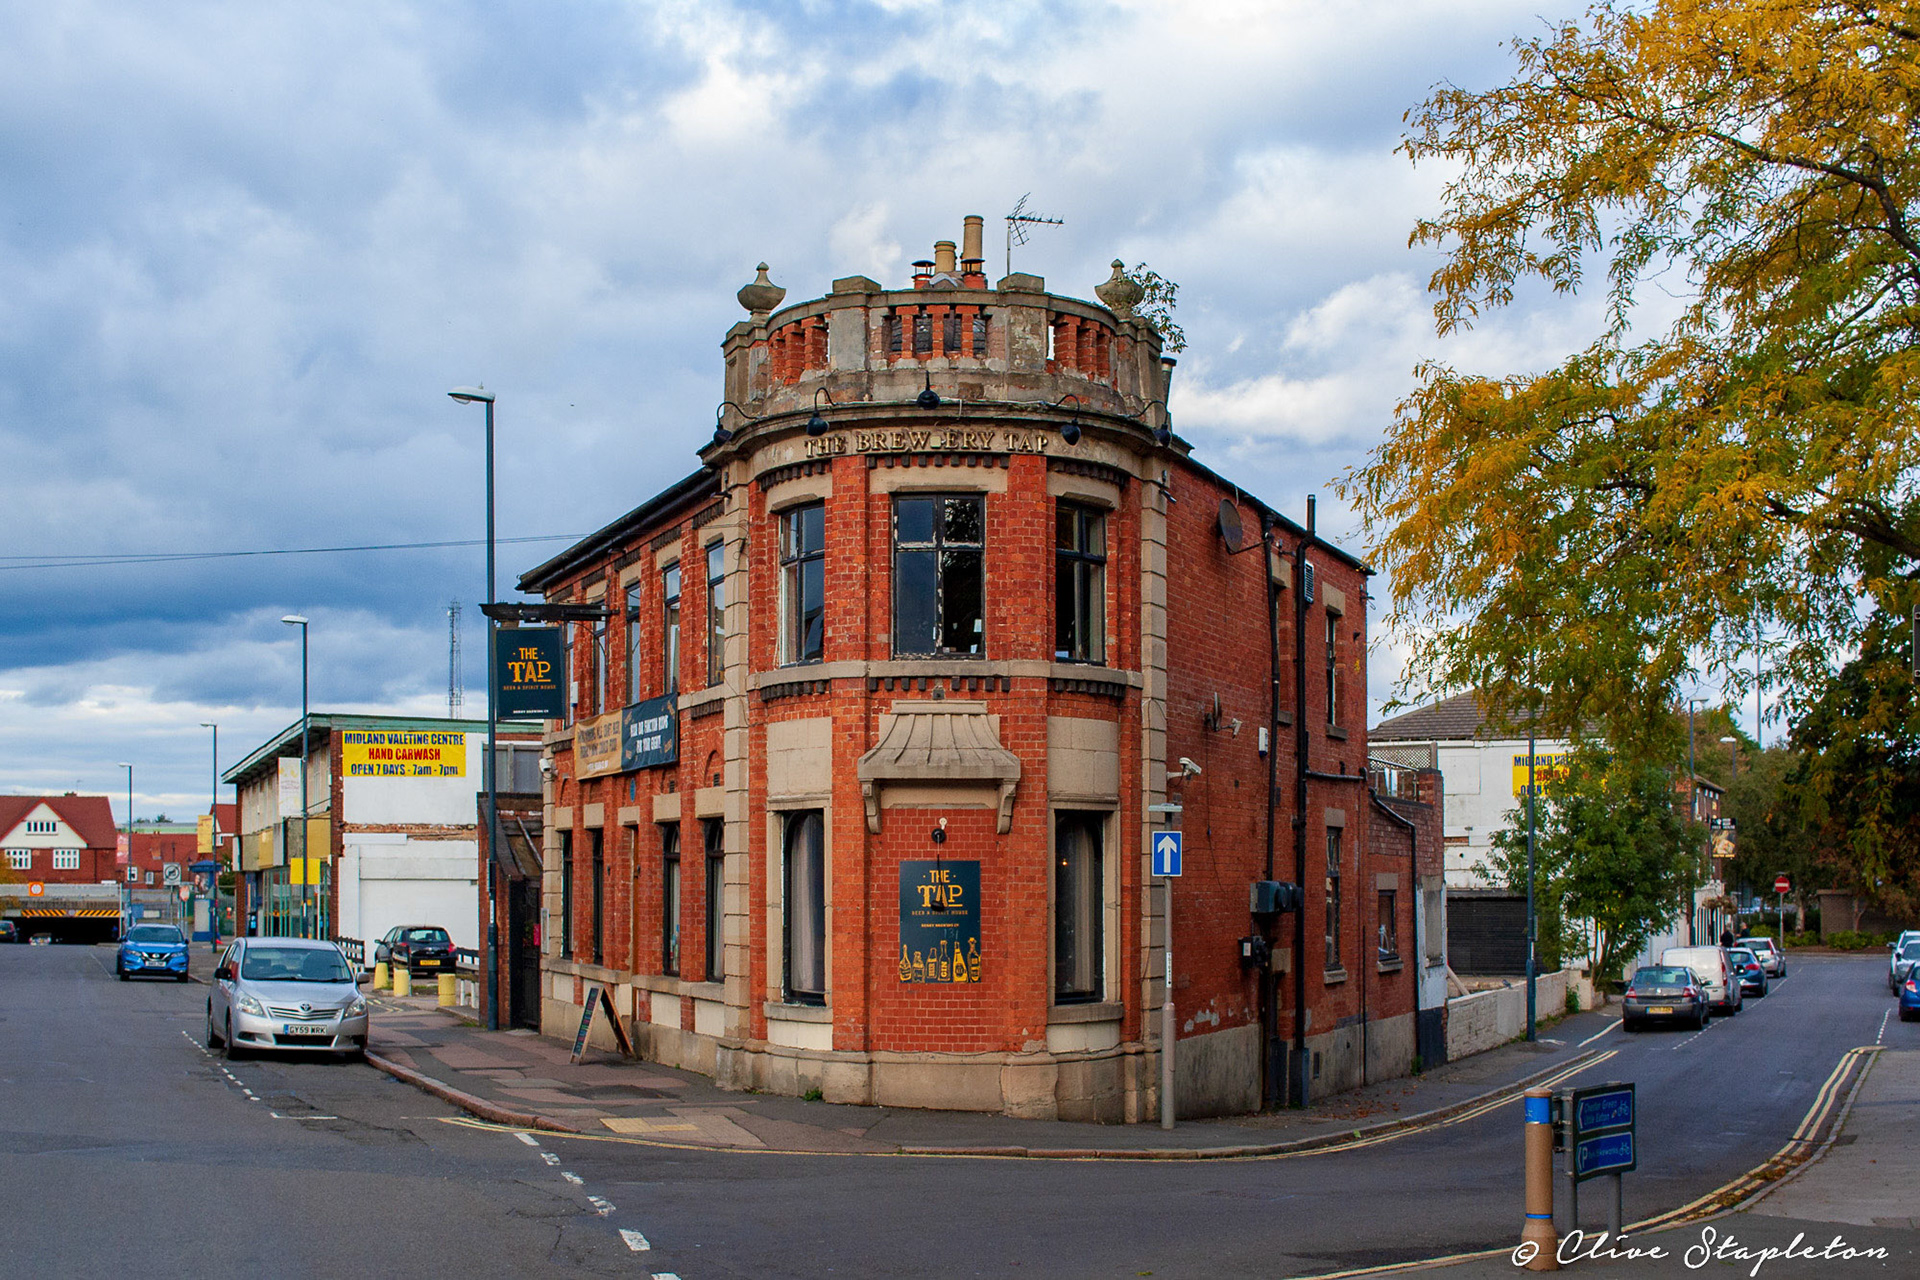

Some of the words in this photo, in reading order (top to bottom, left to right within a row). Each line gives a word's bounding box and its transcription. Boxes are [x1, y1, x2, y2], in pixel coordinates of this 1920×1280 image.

[805, 435, 846, 458] THE
[856, 430, 995, 453] BREWERY
[1003, 432, 1049, 453] TAP
[518, 647, 539, 660] THE
[507, 661, 551, 683] TAP
[344, 733, 386, 745] MIDLAND
[387, 733, 429, 745] VALETING
[430, 734, 464, 745] CENTRE
[368, 748, 393, 760] HAND
[395, 748, 441, 760] CARWASH
[1514, 755, 1552, 766] MIDAND
[351, 763, 374, 775] OPEN
[376, 764, 381, 775] 7
[382, 764, 406, 775] DAYS
[412, 764, 432, 775] 7am
[439, 764, 458, 776] 7pm
[929, 869, 950, 883] THE
[916, 884, 963, 908] TAP
